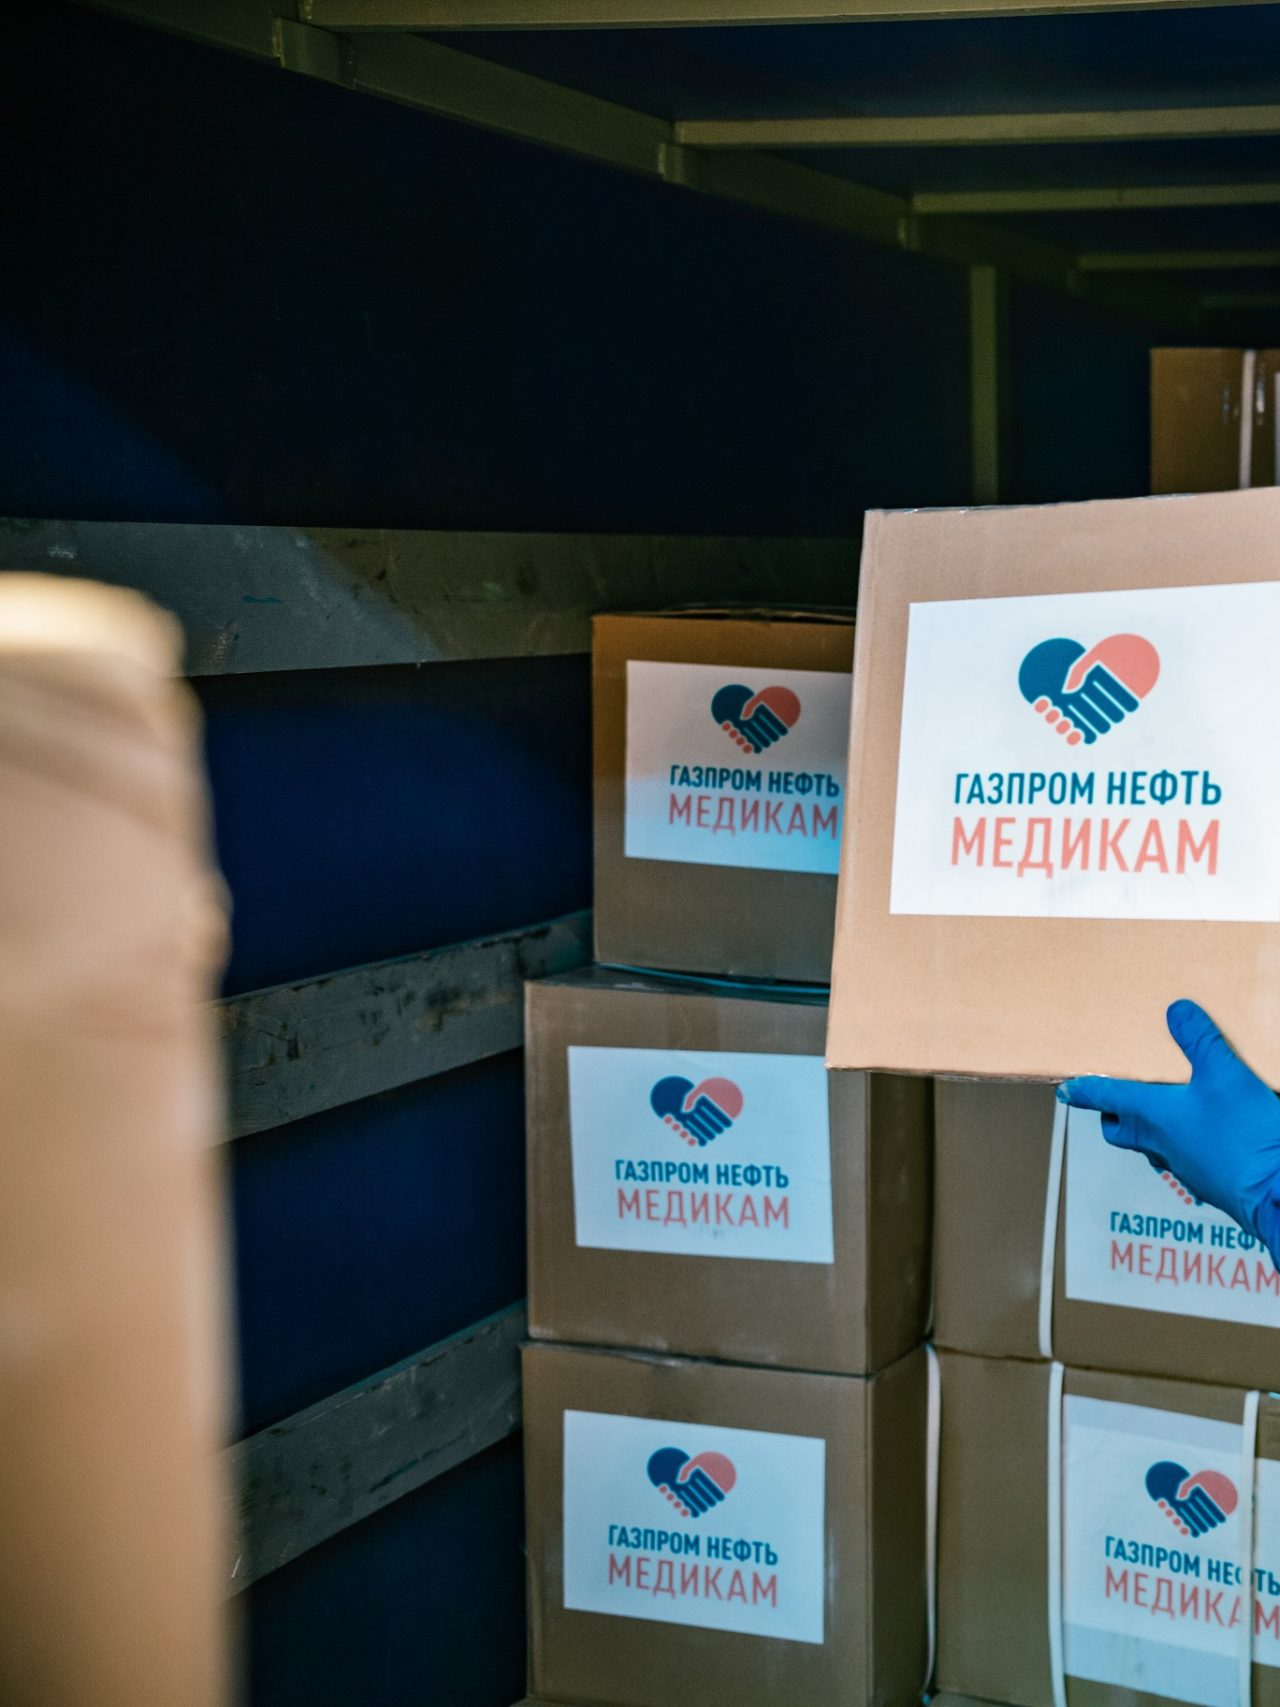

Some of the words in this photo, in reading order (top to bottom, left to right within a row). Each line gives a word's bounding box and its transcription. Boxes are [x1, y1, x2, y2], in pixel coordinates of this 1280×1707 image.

[670, 765, 761, 791] ГАЗПРОМ
[768, 771, 840, 798] НЕФТЬ
[954, 772, 1095, 805] ГАЗПРОМ
[1107, 769, 1222, 805] НЕФТЬ
[668, 793, 839, 840] МЕДИКАМ
[951, 817, 1220, 879] МЕДИКАМ
[615, 1159, 709, 1185] ГАЗПРОМ
[716, 1164, 789, 1189] НЕФТЬ
[617, 1188, 790, 1229] МЕДИКАМ
[1110, 1211, 1203, 1244] ГАЗПРОМ
[1210, 1225, 1266, 1253] НЕФ
[1110, 1240, 1280, 1297] МЕДИКАМ
[608, 1524, 700, 1556] ГАЗПРОМ
[706, 1536, 778, 1566] НЕФТЬ
[1104, 1535, 1200, 1578] ГАЗПРОМ
[608, 1553, 778, 1609] МЕДИКАМ
